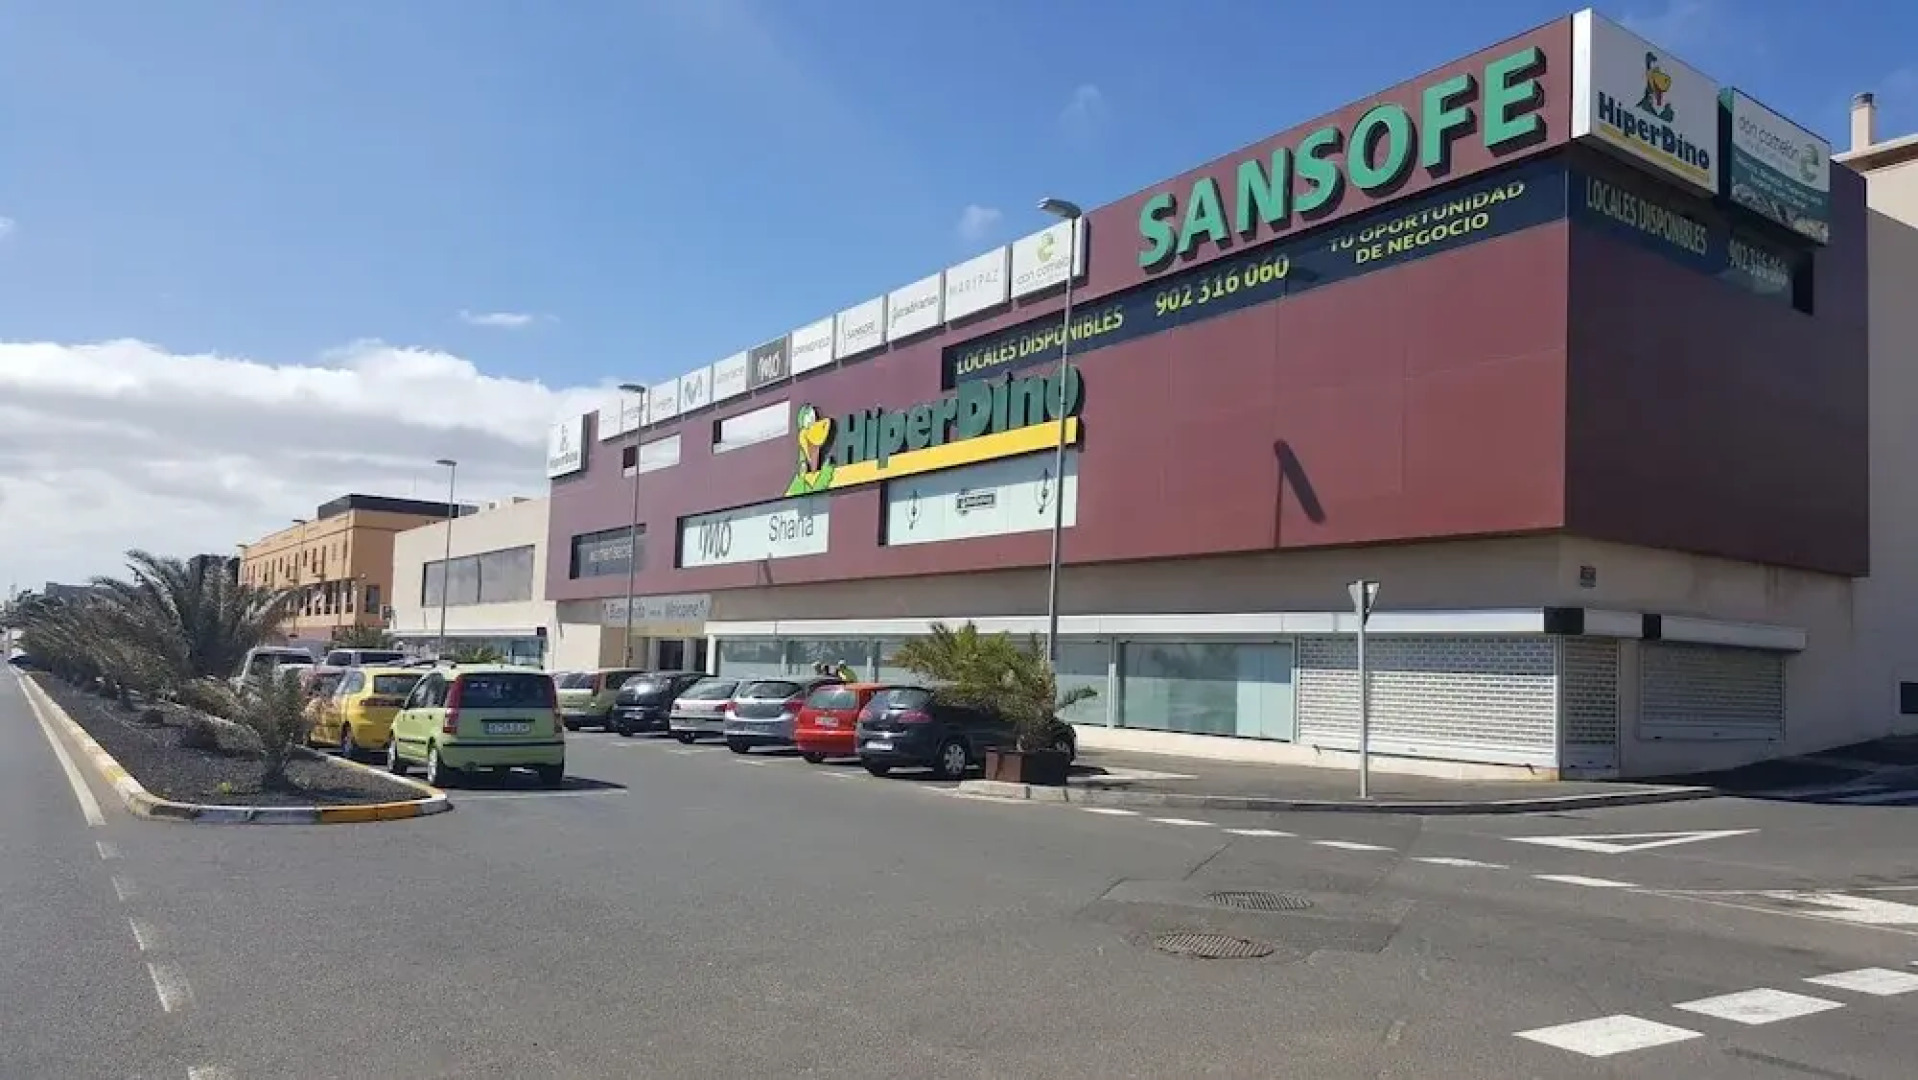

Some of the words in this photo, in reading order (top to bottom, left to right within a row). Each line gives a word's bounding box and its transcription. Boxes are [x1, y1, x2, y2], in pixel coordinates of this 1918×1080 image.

[1138, 46, 1543, 268] SANSOFE
[1598, 91, 1710, 169] HiperDino
[1329, 234, 1354, 252] TU
[1358, 181, 1526, 243] OPORTUNIDAD
[1355, 243, 1384, 264] DE
[1387, 212, 1490, 254] NEGOCIO
[1585, 176, 1637, 227] LOCALES
[1639, 197, 1707, 255] DISPONIBLES
[1155, 283, 1192, 317] 902
[1198, 267, 1240, 304] 316
[1244, 252, 1290, 287] 060
[956, 338, 1017, 375] LOCALES
[1019, 305, 1124, 358] DISPONIBLES
[837, 365, 1079, 470] HiperDino
